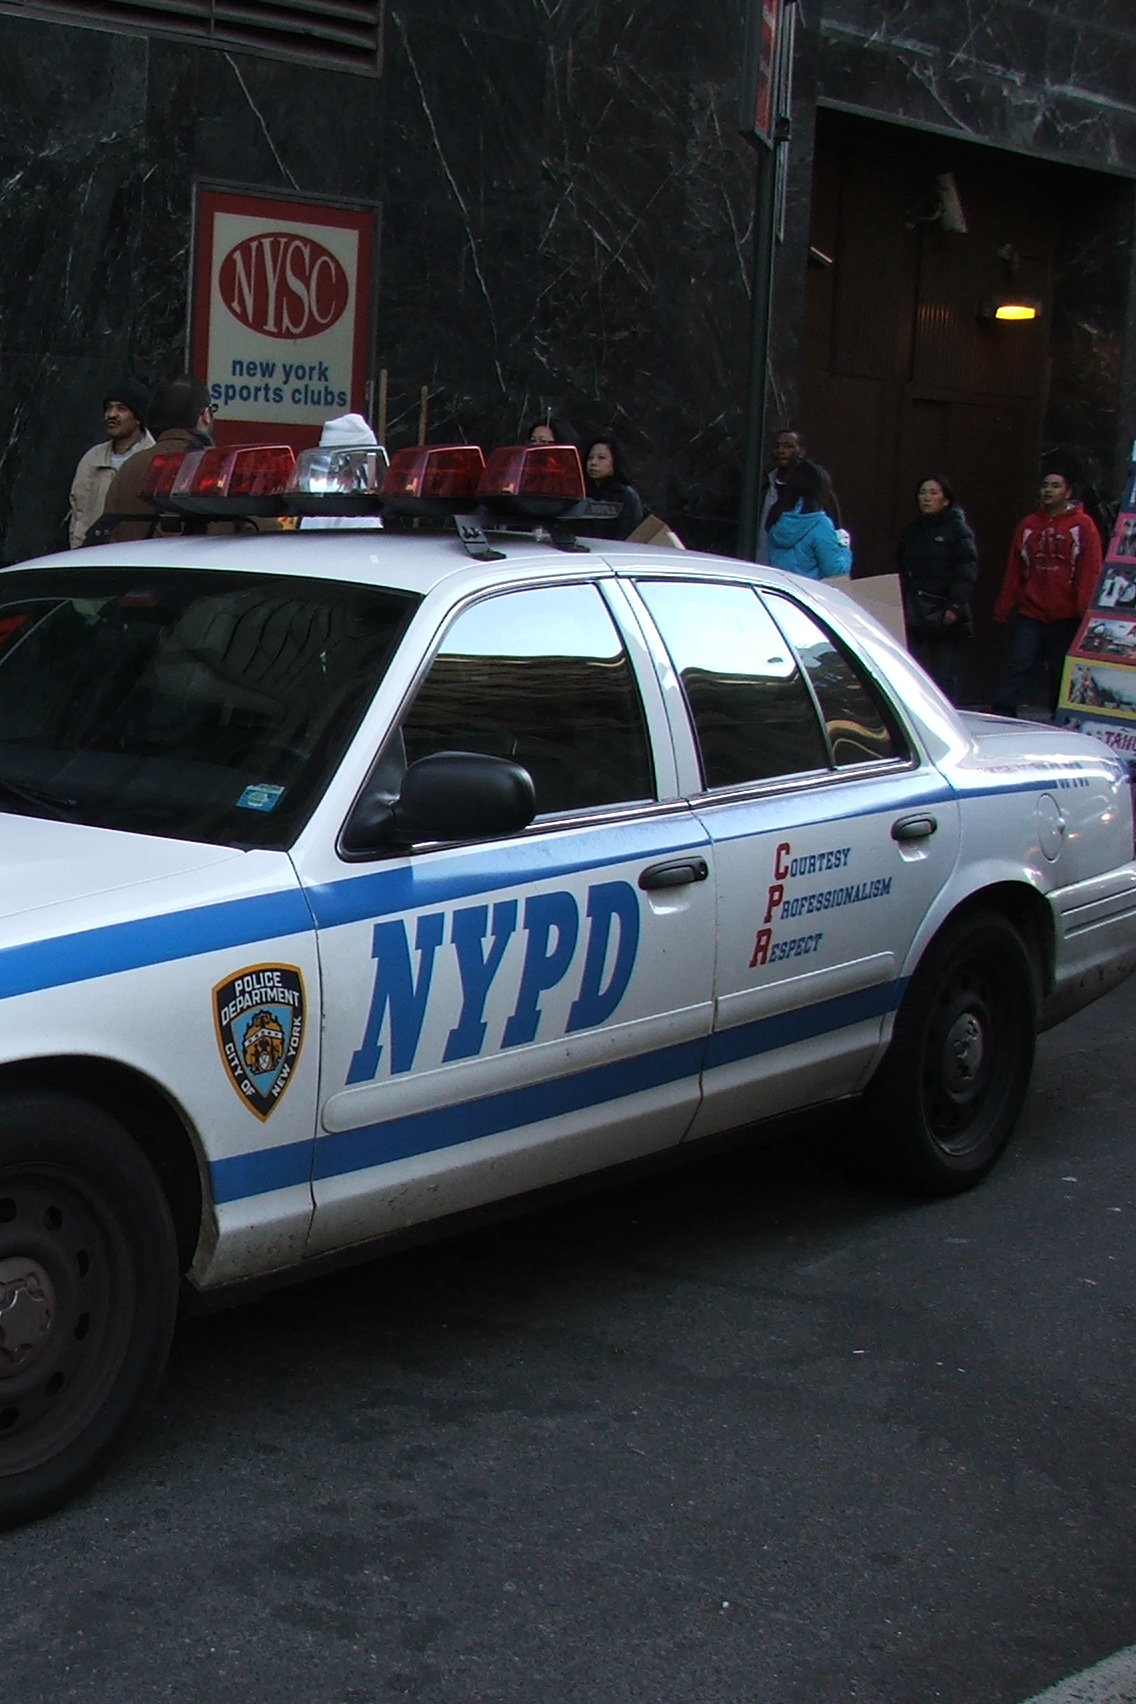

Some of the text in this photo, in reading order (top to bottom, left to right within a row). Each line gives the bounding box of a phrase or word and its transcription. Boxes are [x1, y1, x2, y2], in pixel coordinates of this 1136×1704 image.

[230, 237, 336, 335] NYSC
[231, 359, 329, 385] new york
[210, 383, 347, 407] sports clubs
[774, 842, 851, 880] COURTESY
[763, 877, 892, 924] PROFESSIONALISM
[748, 927, 823, 968] RESPECT
[234, 971, 282, 997] POLICE
[345, 880, 641, 1085] NYPD
[221, 987, 300, 1026] DEPARTMENT
[225, 1016, 302, 1097] CITY OF NEW YORK
